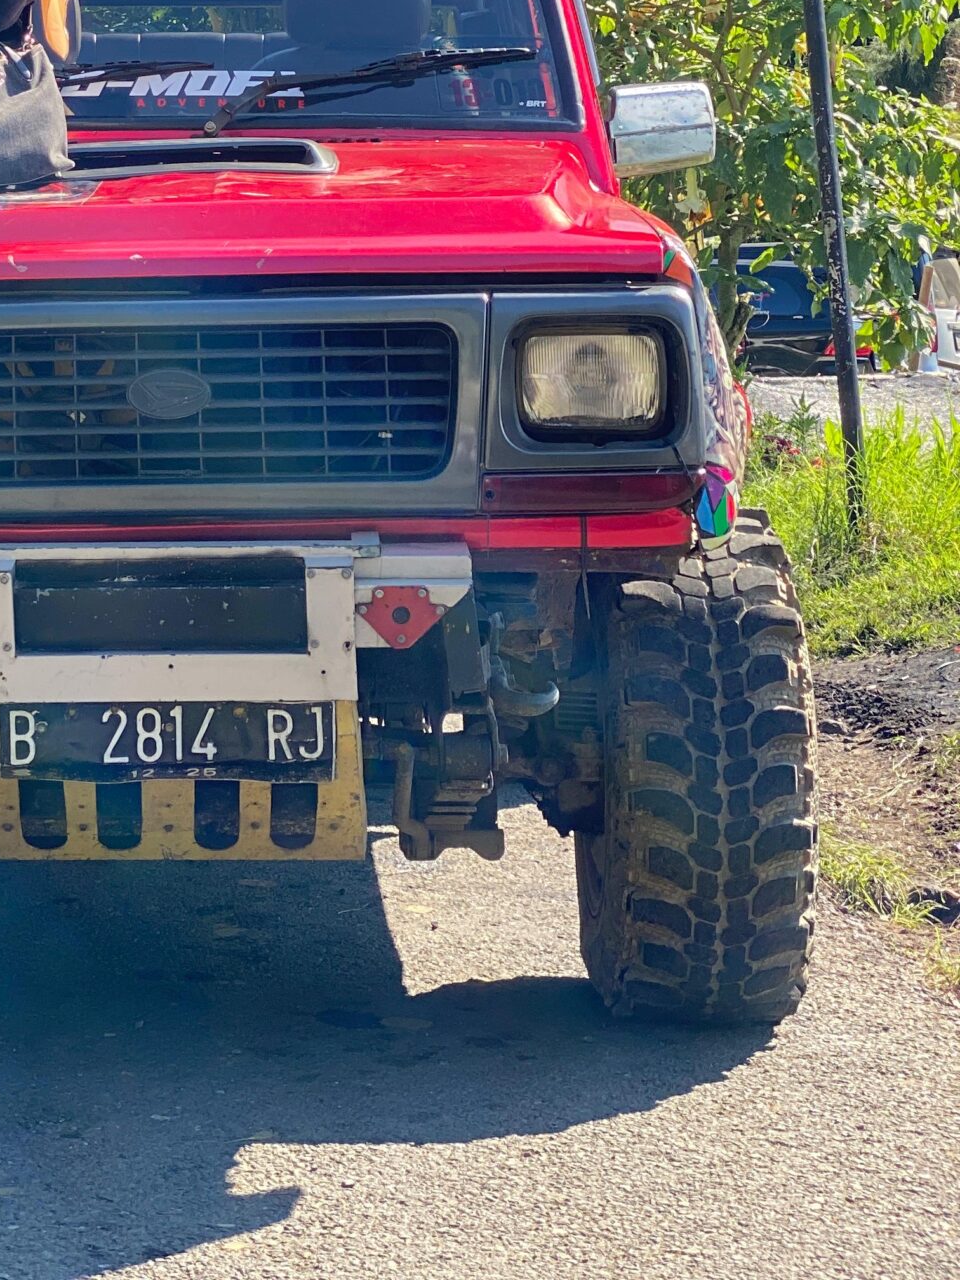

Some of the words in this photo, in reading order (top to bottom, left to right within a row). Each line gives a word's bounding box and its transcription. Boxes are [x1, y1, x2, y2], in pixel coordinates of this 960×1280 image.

[136, 98, 305, 108] ADVENURE
[9, 710, 36, 766] B
[101, 706, 218, 763] 2814
[266, 706, 324, 761] RJ
[130, 769, 155, 779] 12
[187, 767, 217, 778] 25
